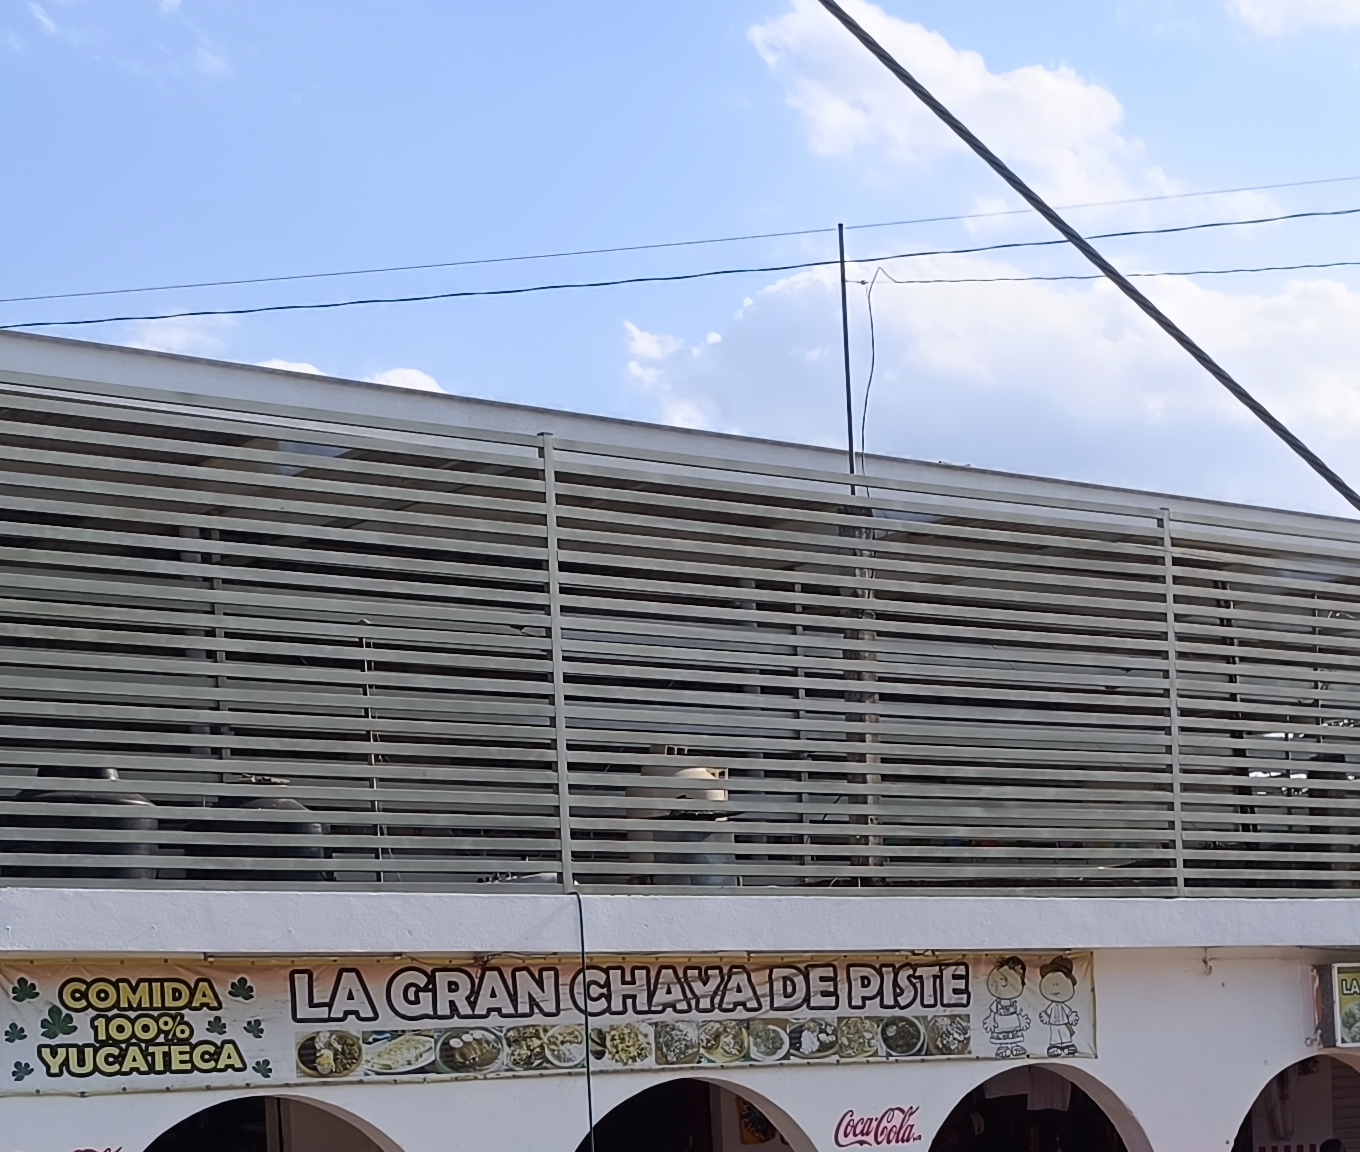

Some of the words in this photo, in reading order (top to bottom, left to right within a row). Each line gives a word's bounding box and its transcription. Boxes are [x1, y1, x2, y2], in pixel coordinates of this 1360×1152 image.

[58, 977, 222, 1011] COMIDA
[289, 969, 379, 1023] LA
[386, 966, 560, 1020] GRAN
[570, 965, 762, 1016] CHAYA
[768, 964, 839, 1011] DE
[846, 962, 972, 1009] PISTE
[1341, 979, 1360, 995] LA
[90, 1013, 193, 1043] 100%
[38, 1039, 247, 1077] YUCATECA
[834, 1106, 920, 1147] Coca-Cola
